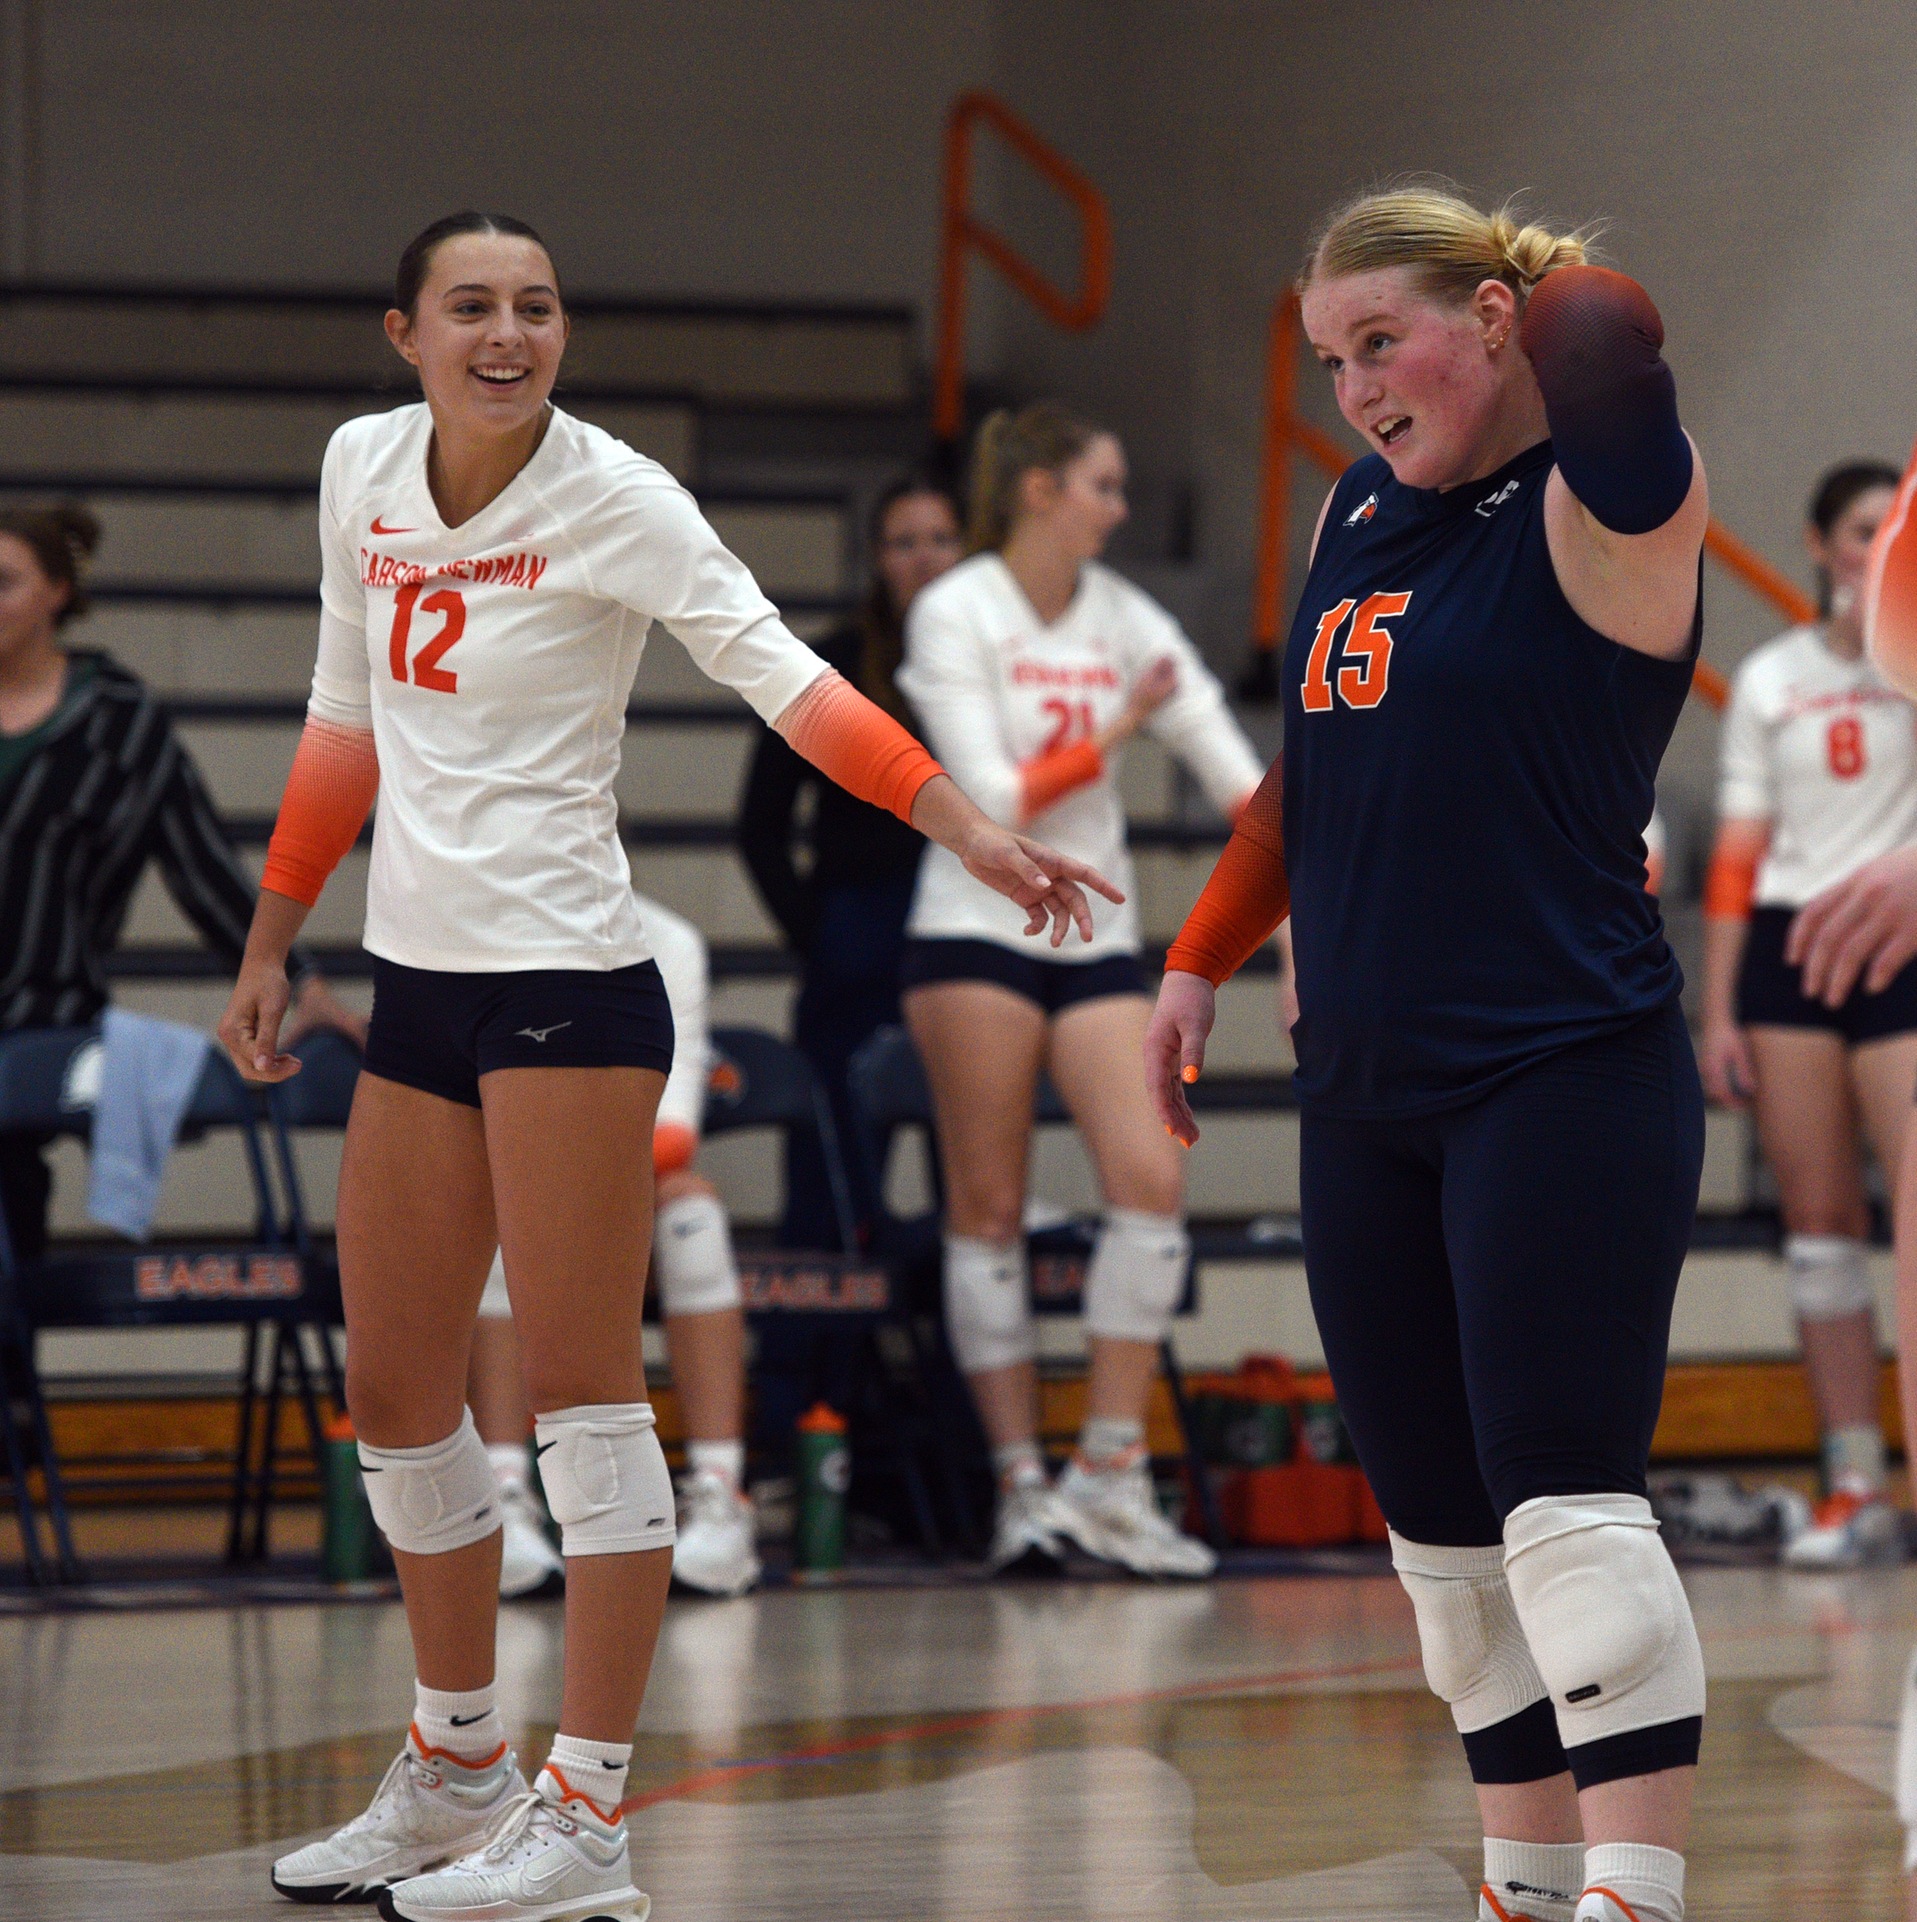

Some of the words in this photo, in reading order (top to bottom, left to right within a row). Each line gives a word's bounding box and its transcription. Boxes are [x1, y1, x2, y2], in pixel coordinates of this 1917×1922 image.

[389, 583, 466, 693] 12
[1301, 591, 1413, 713] 15
[1827, 717, 1865, 780] 8
[135, 1254, 303, 1301] EAGLES
